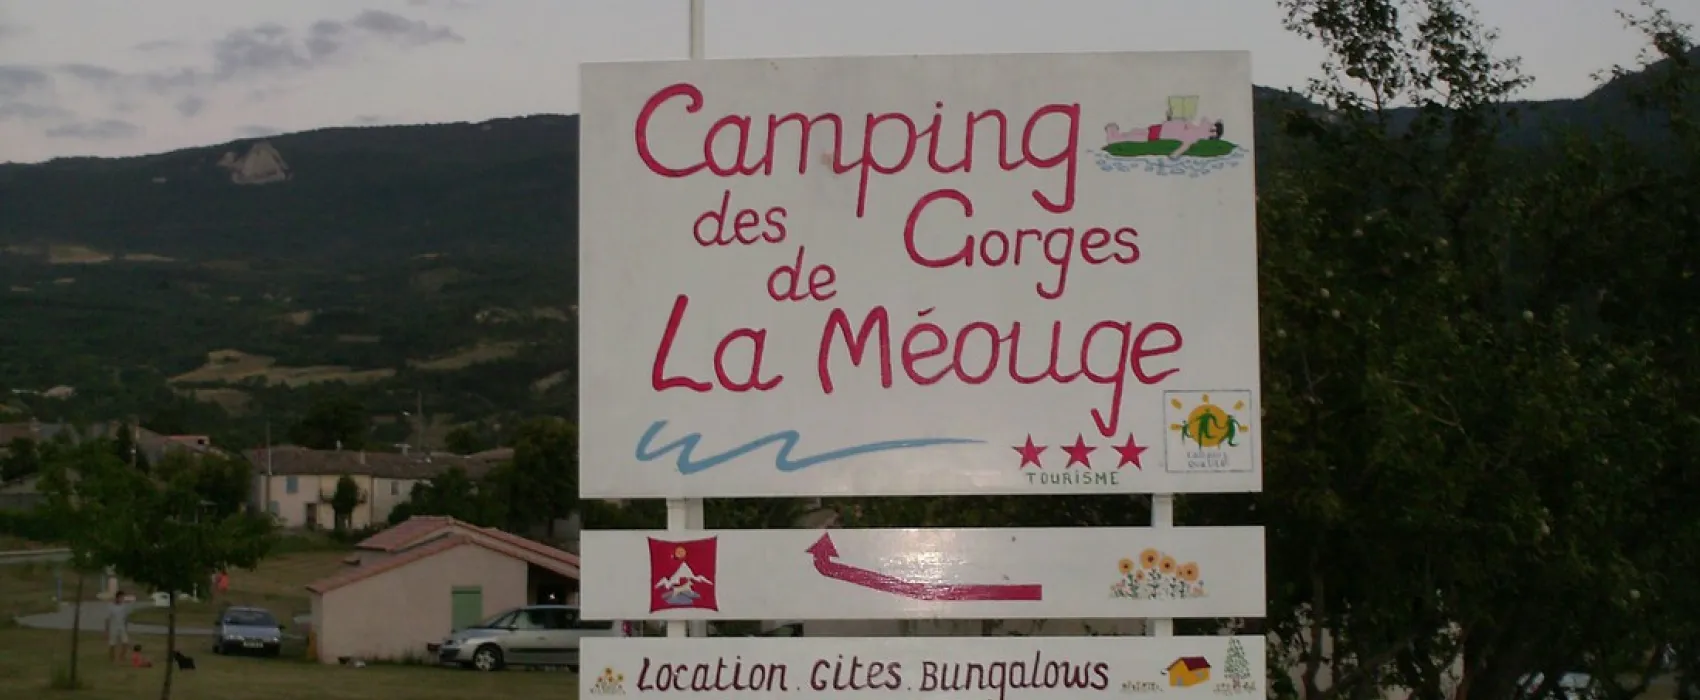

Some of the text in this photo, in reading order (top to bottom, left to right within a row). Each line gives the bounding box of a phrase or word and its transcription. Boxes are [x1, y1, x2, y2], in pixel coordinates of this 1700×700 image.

[634, 83, 1081, 217] Camping
[693, 188, 1140, 300] des Gorges
[767, 248, 837, 303] de
[651, 295, 1184, 438] La Méouge
